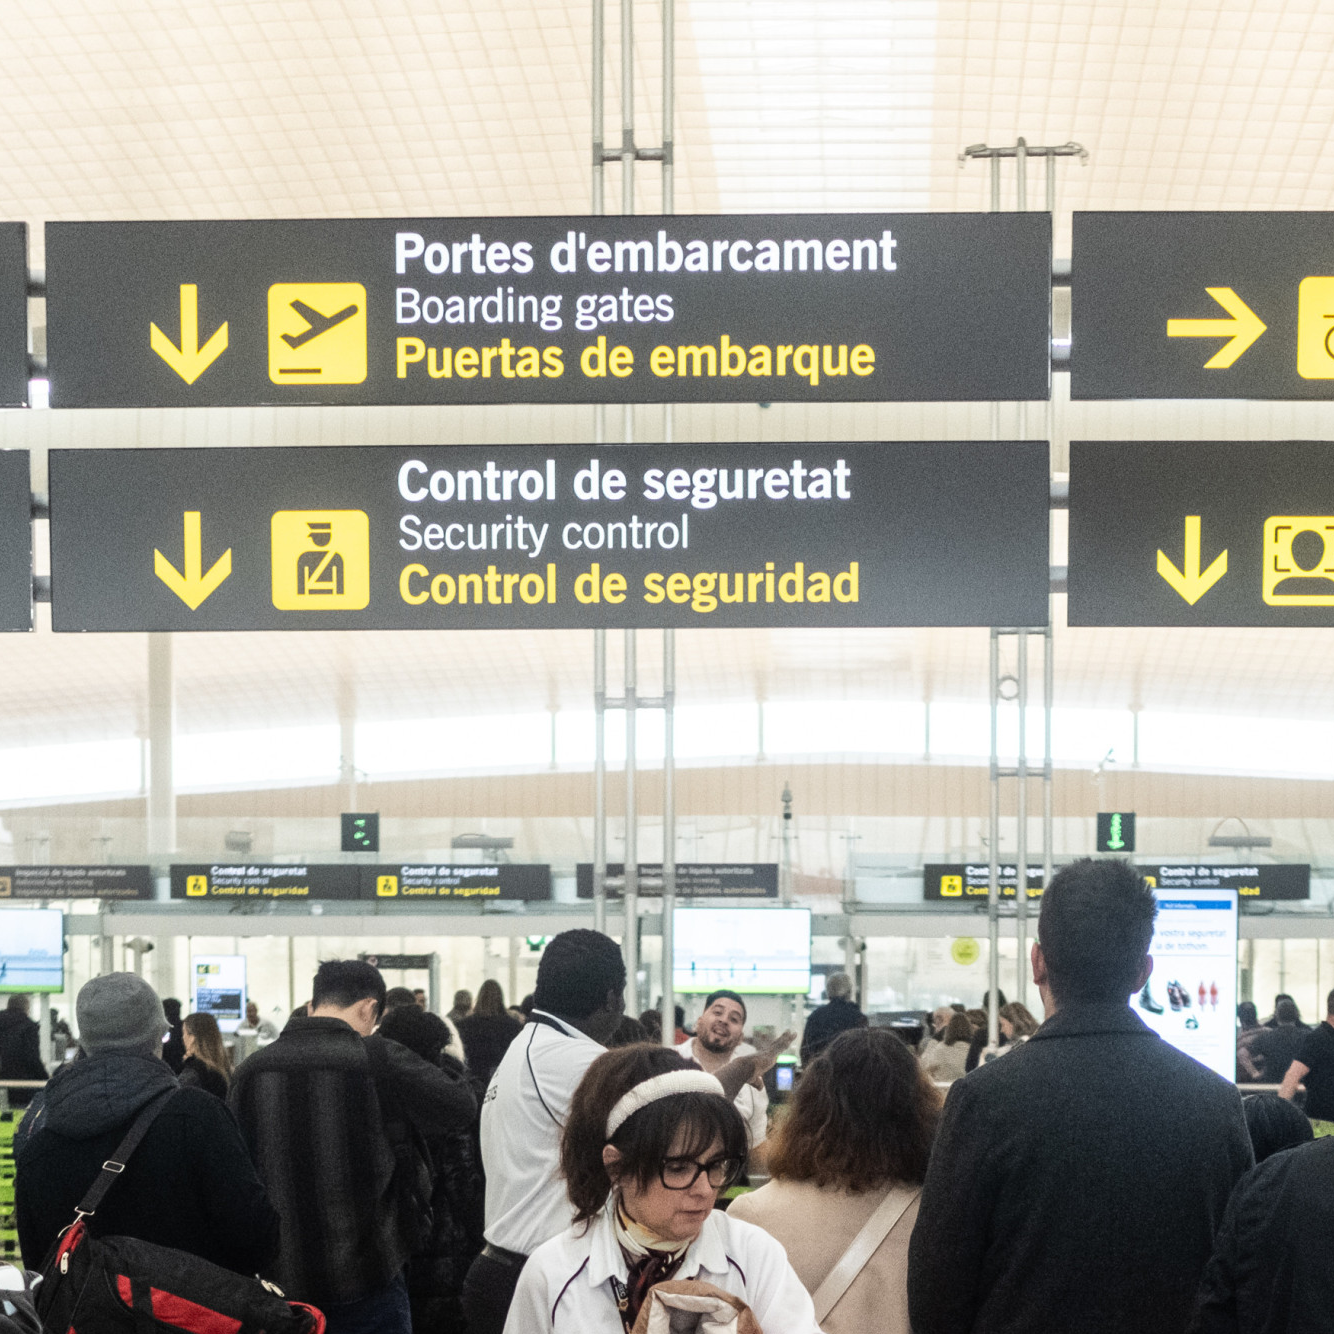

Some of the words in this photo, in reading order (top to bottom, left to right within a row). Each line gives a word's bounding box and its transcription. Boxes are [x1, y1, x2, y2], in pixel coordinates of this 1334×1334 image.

[395, 232, 534, 275] Portes
[550, 230, 897, 274] d'embarcament
[396, 286, 563, 332] Boarding
[575, 287, 674, 332] gates
[396, 337, 564, 379] Puertas
[580, 335, 634, 378] de
[650, 334, 875, 386] embarque
[398, 459, 555, 503] Control
[573, 459, 627, 502] de
[643, 459, 851, 510] seguretat
[399, 514, 549, 558] Security
[562, 513, 688, 550] control
[399, 563, 556, 605] Control
[574, 563, 627, 604] de
[643, 561, 859, 613] seguridad
[211, 866, 245, 876] Control
[247, 866, 259, 876] de
[262, 866, 307, 877] seguretat
[211, 886, 245, 895] Control
[248, 886, 259, 895] de
[262, 886, 309, 897] seguridad
[401, 866, 436, 876] Control
[438, 866, 450, 876] de
[453, 866, 499, 877] seguretat
[402, 886, 436, 895] Control
[439, 886, 450, 895] de
[453, 886, 500, 897] seguridad
[1160, 867, 1196, 876] Control
[1197, 867, 1210, 876] de
[1212, 867, 1259, 878] seguretat
